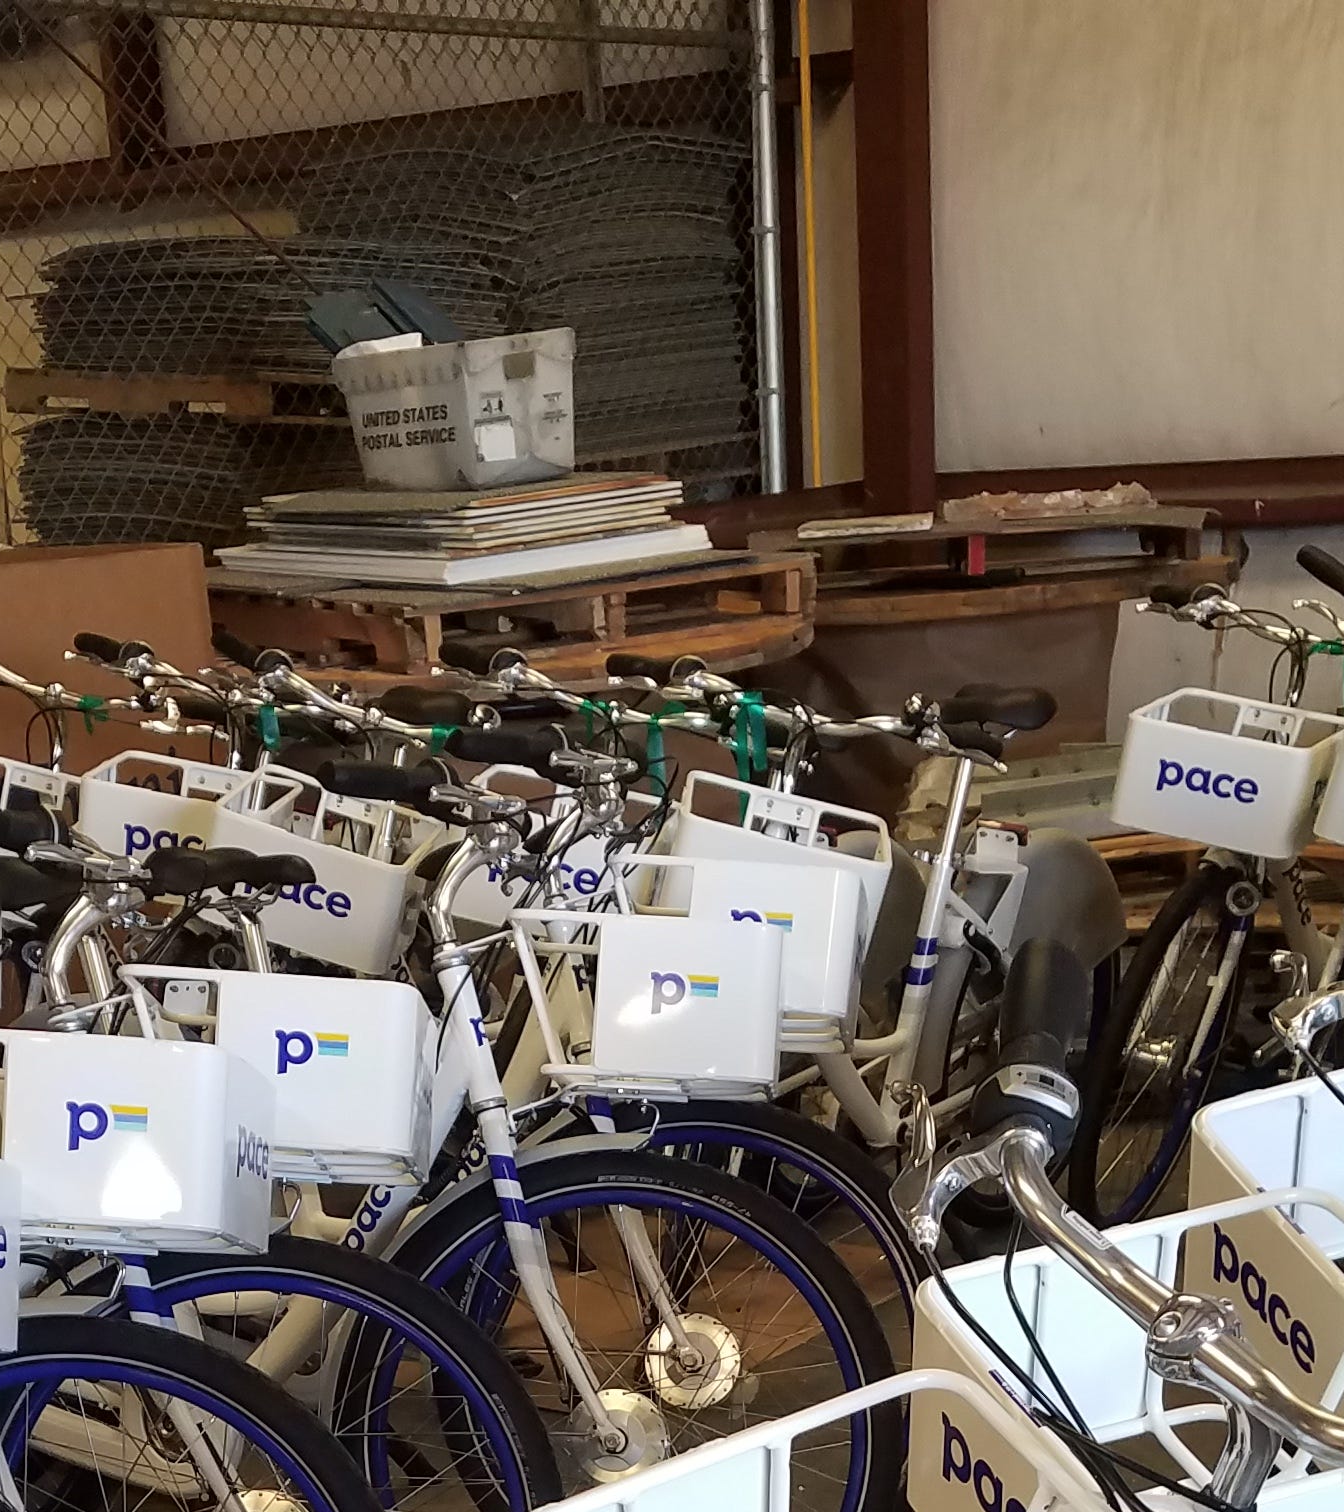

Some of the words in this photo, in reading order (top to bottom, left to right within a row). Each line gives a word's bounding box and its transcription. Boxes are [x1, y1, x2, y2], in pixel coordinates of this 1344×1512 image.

[362, 410, 400, 428] UNITED
[403, 404, 448, 424] STATES
[362, 431, 402, 450] POSTAL
[406, 426, 455, 446] SERVICE
[1156, 758, 1259, 803] pace
[651, 971, 686, 1015] p
[275, 1028, 313, 1075] p
[66, 1100, 109, 1152] p
[236, 1122, 270, 1181] pace
[1212, 1221, 1317, 1374] pace
